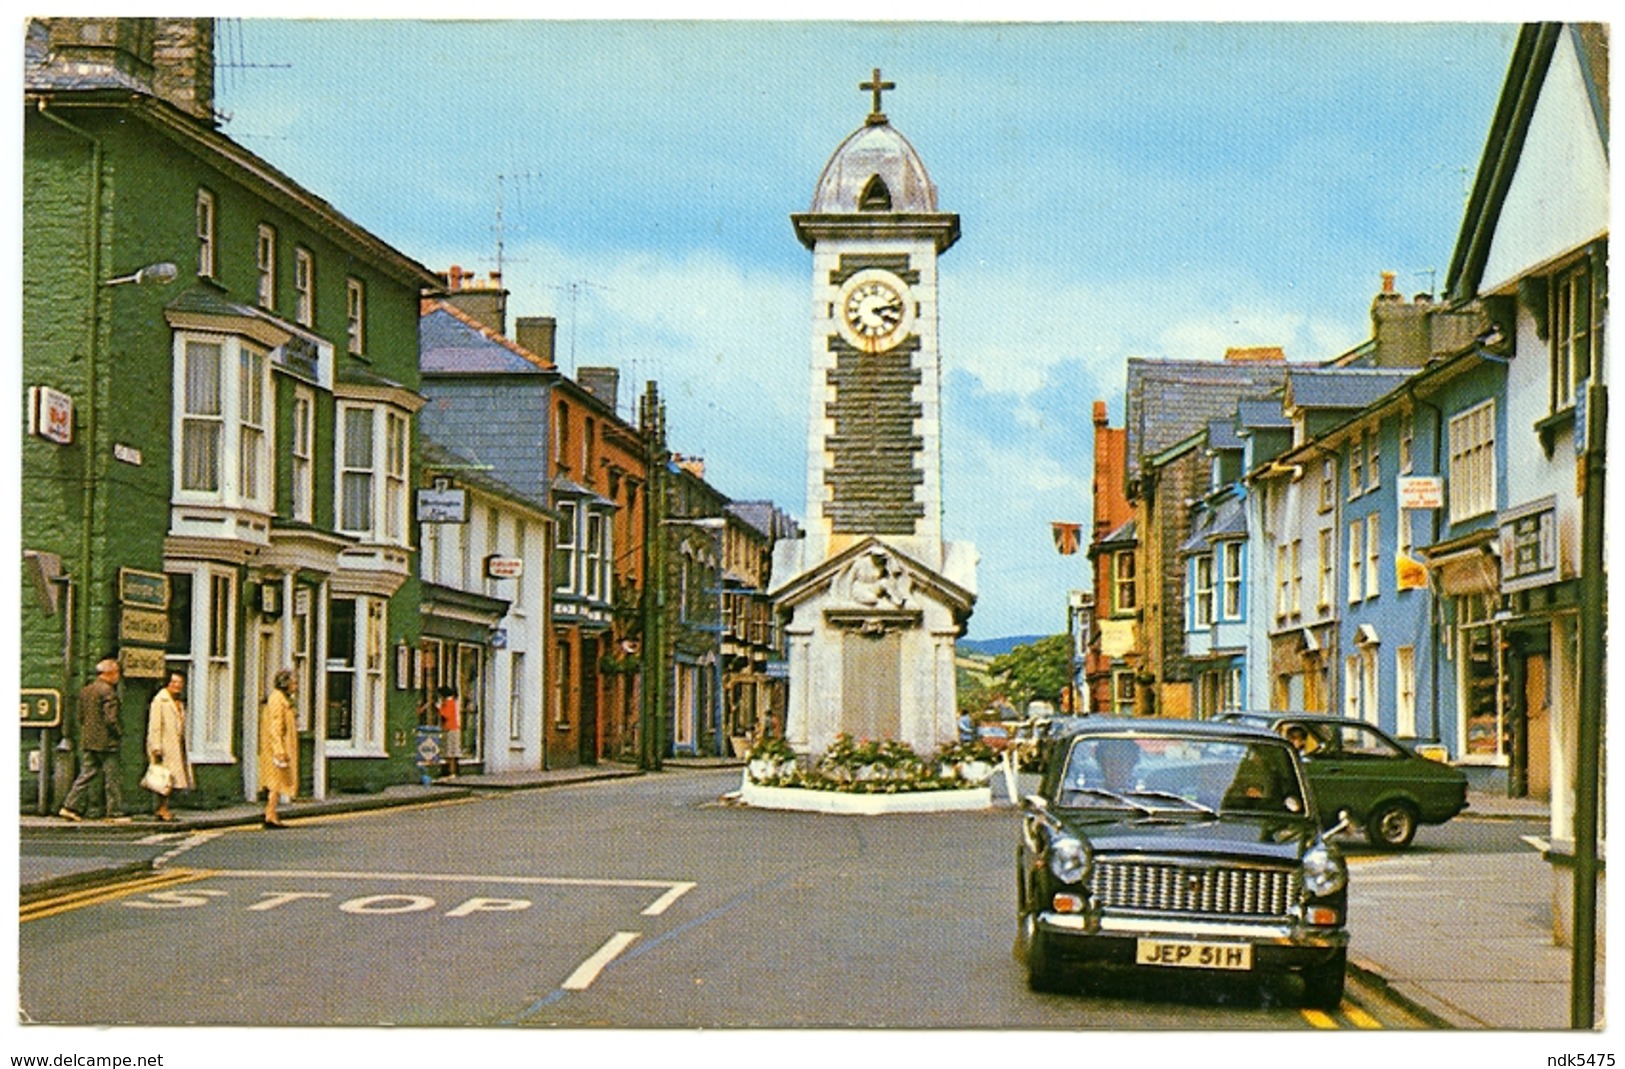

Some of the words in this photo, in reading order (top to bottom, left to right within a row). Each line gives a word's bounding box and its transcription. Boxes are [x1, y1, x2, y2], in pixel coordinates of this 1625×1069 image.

[37, 699, 49, 715] 9
[121, 890, 533, 918] STOP
[1146, 944, 1191, 963] JEP
[1199, 946, 1242, 966] 51H
